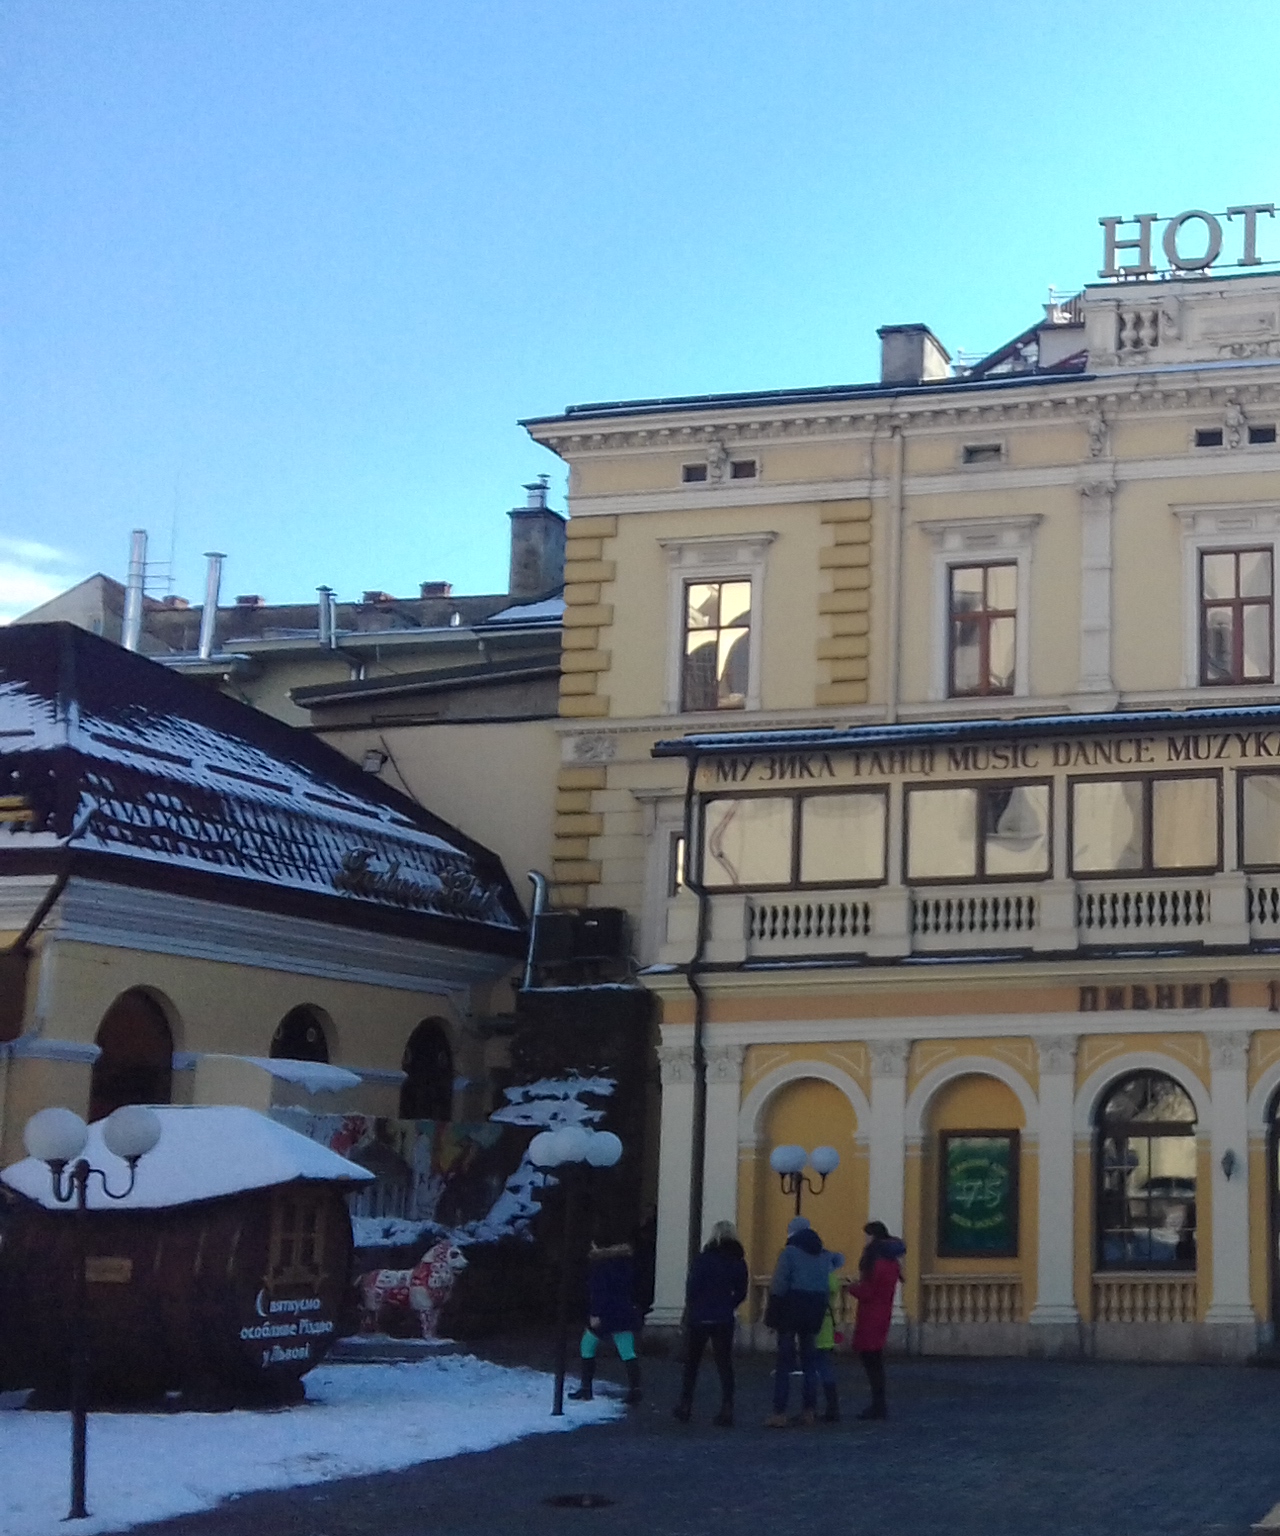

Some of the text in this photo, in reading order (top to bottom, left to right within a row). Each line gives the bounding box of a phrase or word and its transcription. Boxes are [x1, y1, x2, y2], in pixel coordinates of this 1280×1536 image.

[715, 753, 836, 782] МУЗИКА
[849, 749, 936, 777] ТАНЦІ
[946, 742, 1039, 772] MUSIC
[1051, 736, 1155, 767] DANCE
